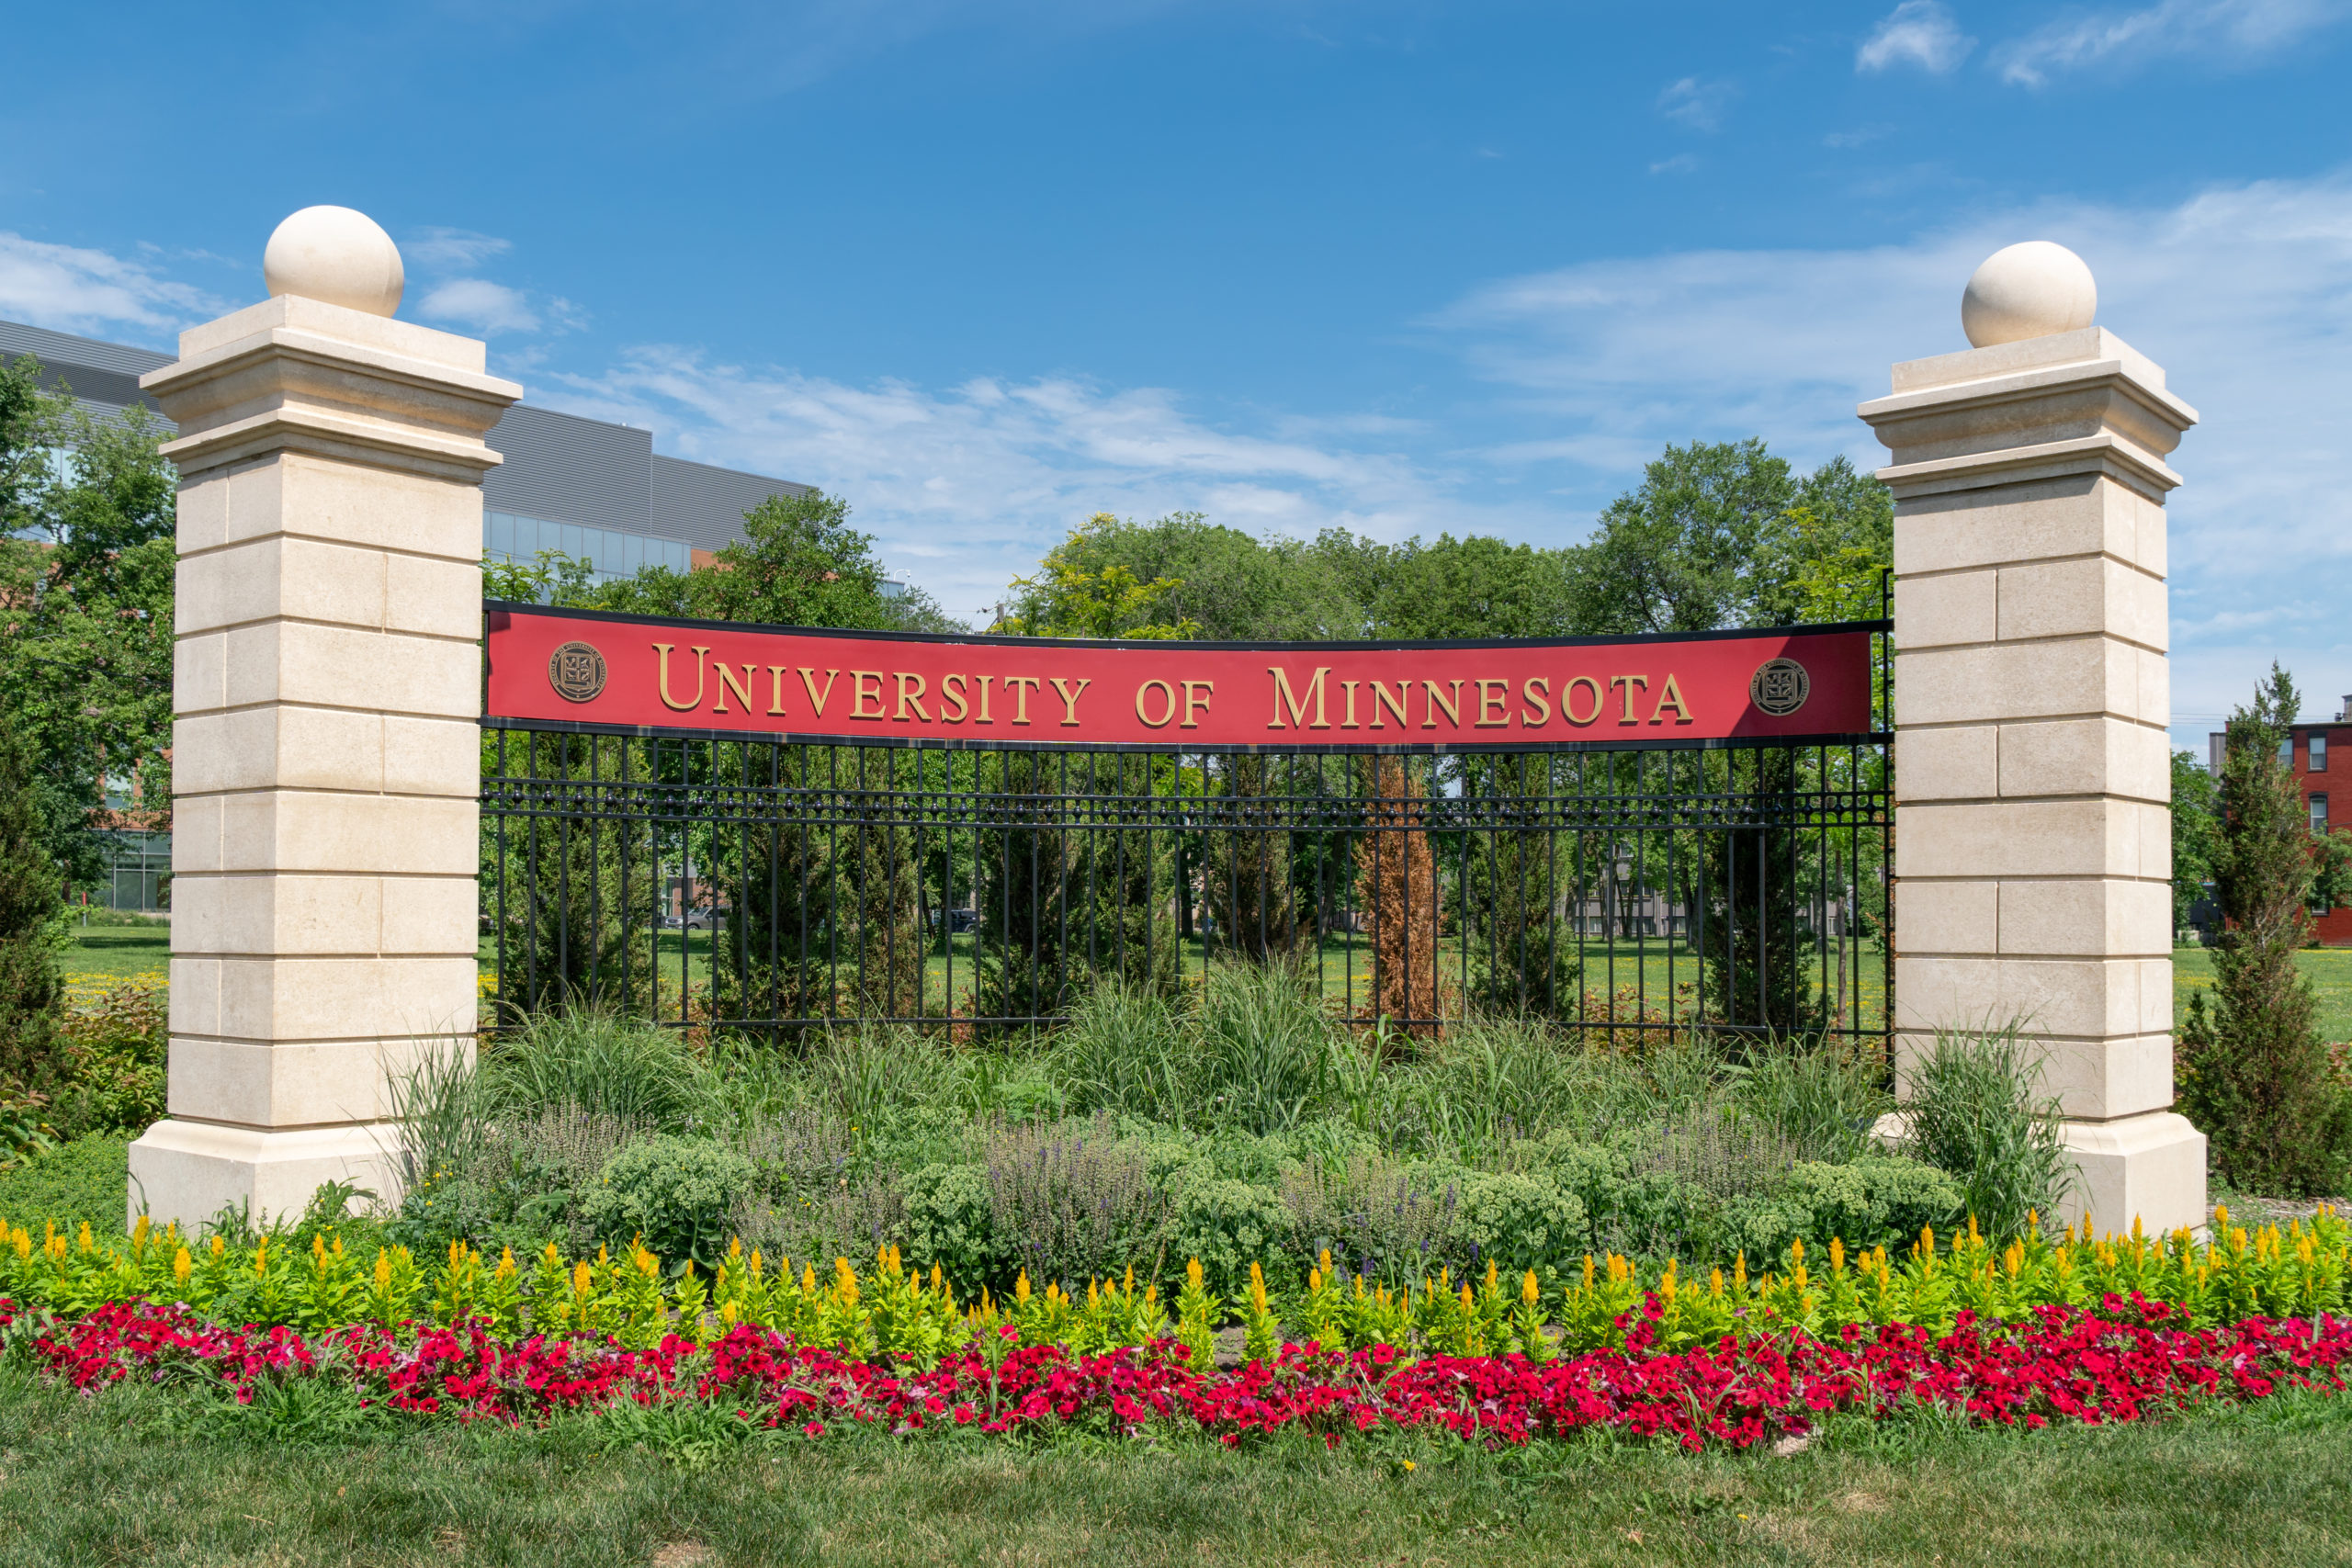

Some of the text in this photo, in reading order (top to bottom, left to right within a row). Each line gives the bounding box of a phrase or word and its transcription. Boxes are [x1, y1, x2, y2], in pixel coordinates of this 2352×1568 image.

[653, 643, 1091, 725] UNIVERSITY
[1136, 679, 1214, 727] OF
[1267, 667, 1693, 727] MINNESOTA
